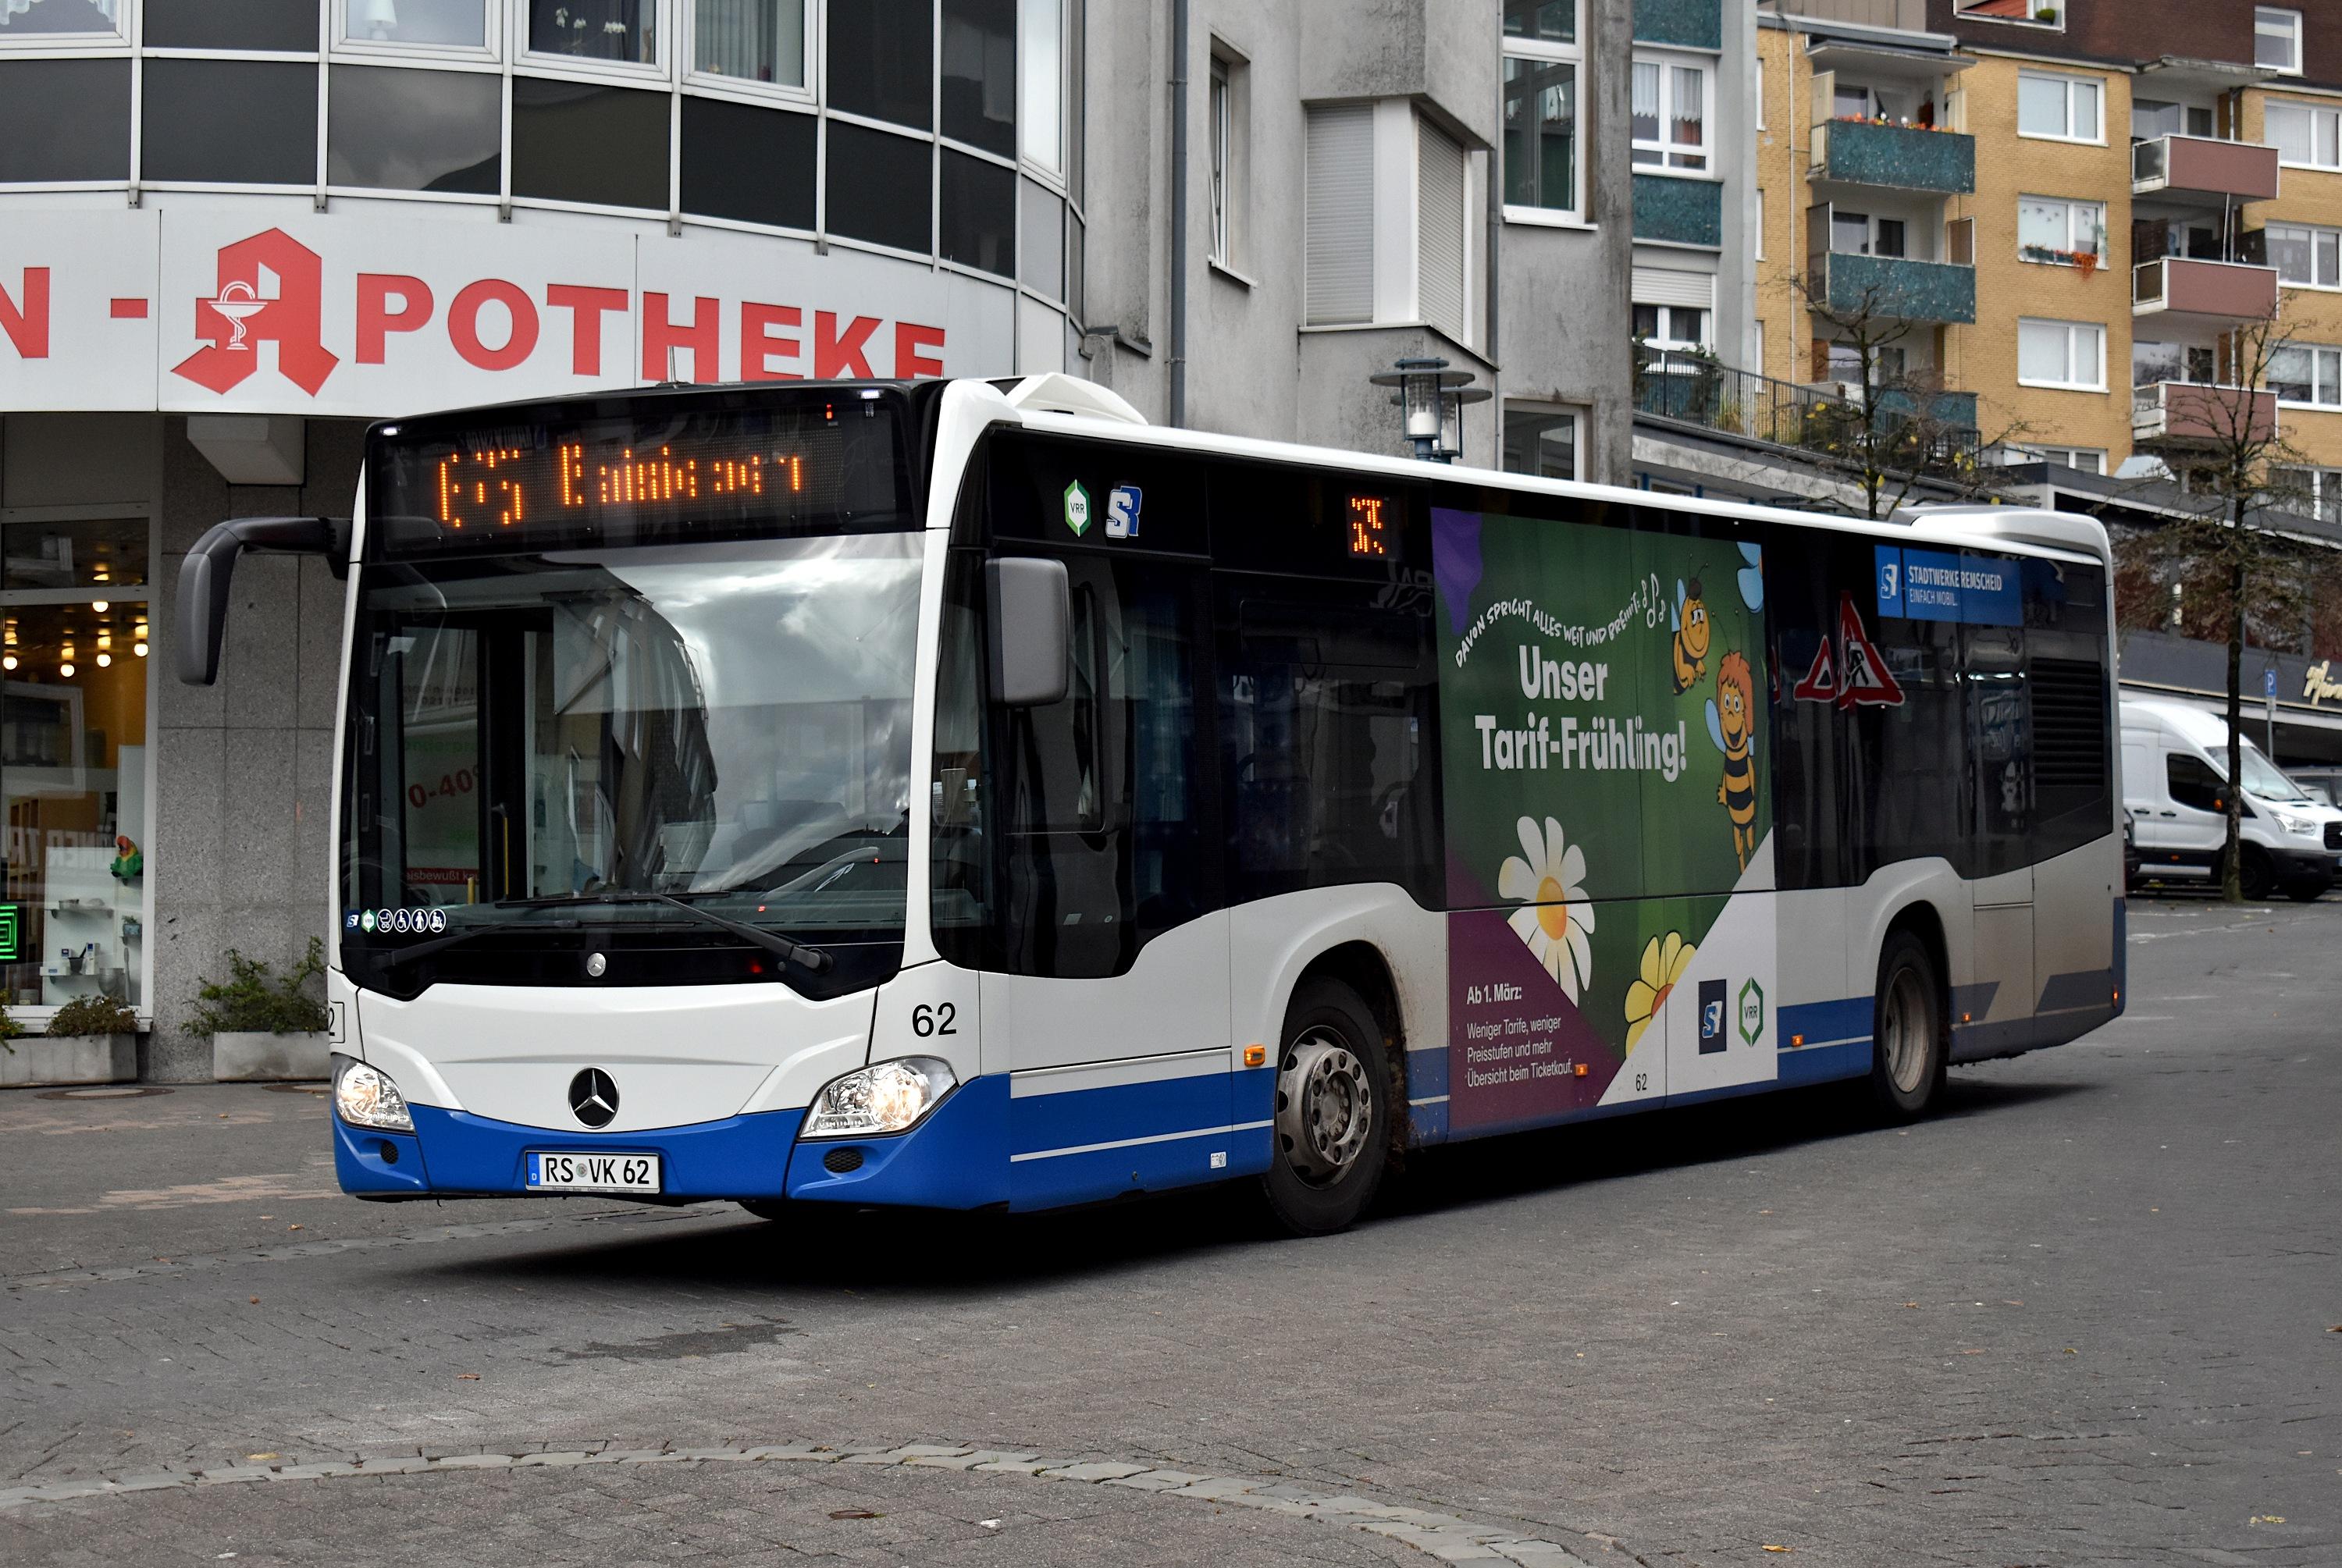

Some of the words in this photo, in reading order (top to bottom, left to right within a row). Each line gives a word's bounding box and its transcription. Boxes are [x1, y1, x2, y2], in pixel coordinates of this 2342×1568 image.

[1070, 502, 1085, 514] VRR
[1908, 565, 1960, 588] STADTWERKE
[1960, 571, 2002, 592] REMSCHEID
[1910, 588, 1935, 603] EINFACH
[1936, 591, 1958, 606] MOBIL.
[1455, 615, 1486, 668] DAVON
[1486, 598, 1532, 624] SPRICHT
[1532, 610, 1562, 637] ALLES
[1563, 625, 1585, 649] WEIT
[1586, 628, 1607, 645] UND
[1518, 645, 1607, 702] Unser
[1475, 711, 1686, 783] Tarif-Frühling!
[1467, 986, 1481, 1004] Ab
[1483, 985, 1492, 1003] 1.
[1493, 983, 1522, 1003] März:
[912, 1002, 957, 1038] 62
[1744, 1005, 1758, 1019] VRR
[1467, 1020, 1502, 1040] Weniger
[1504, 1018, 1529, 1036] Tarife,
[1530, 1015, 1561, 1033] weniger
[1467, 1042, 1513, 1063] Preisstufen
[1514, 1040, 1531, 1058] und
[1532, 1039, 1552, 1055] mehr
[1467, 1066, 1507, 1087] Übersicht
[1509, 1065, 1529, 1083] beim
[1530, 1060, 1573, 1079] Ticketkauf.
[1635, 1073, 1647, 1092] 62
[546, 1157, 574, 1183] RS
[589, 1158, 617, 1184] VK
[624, 1159, 650, 1185] 62
